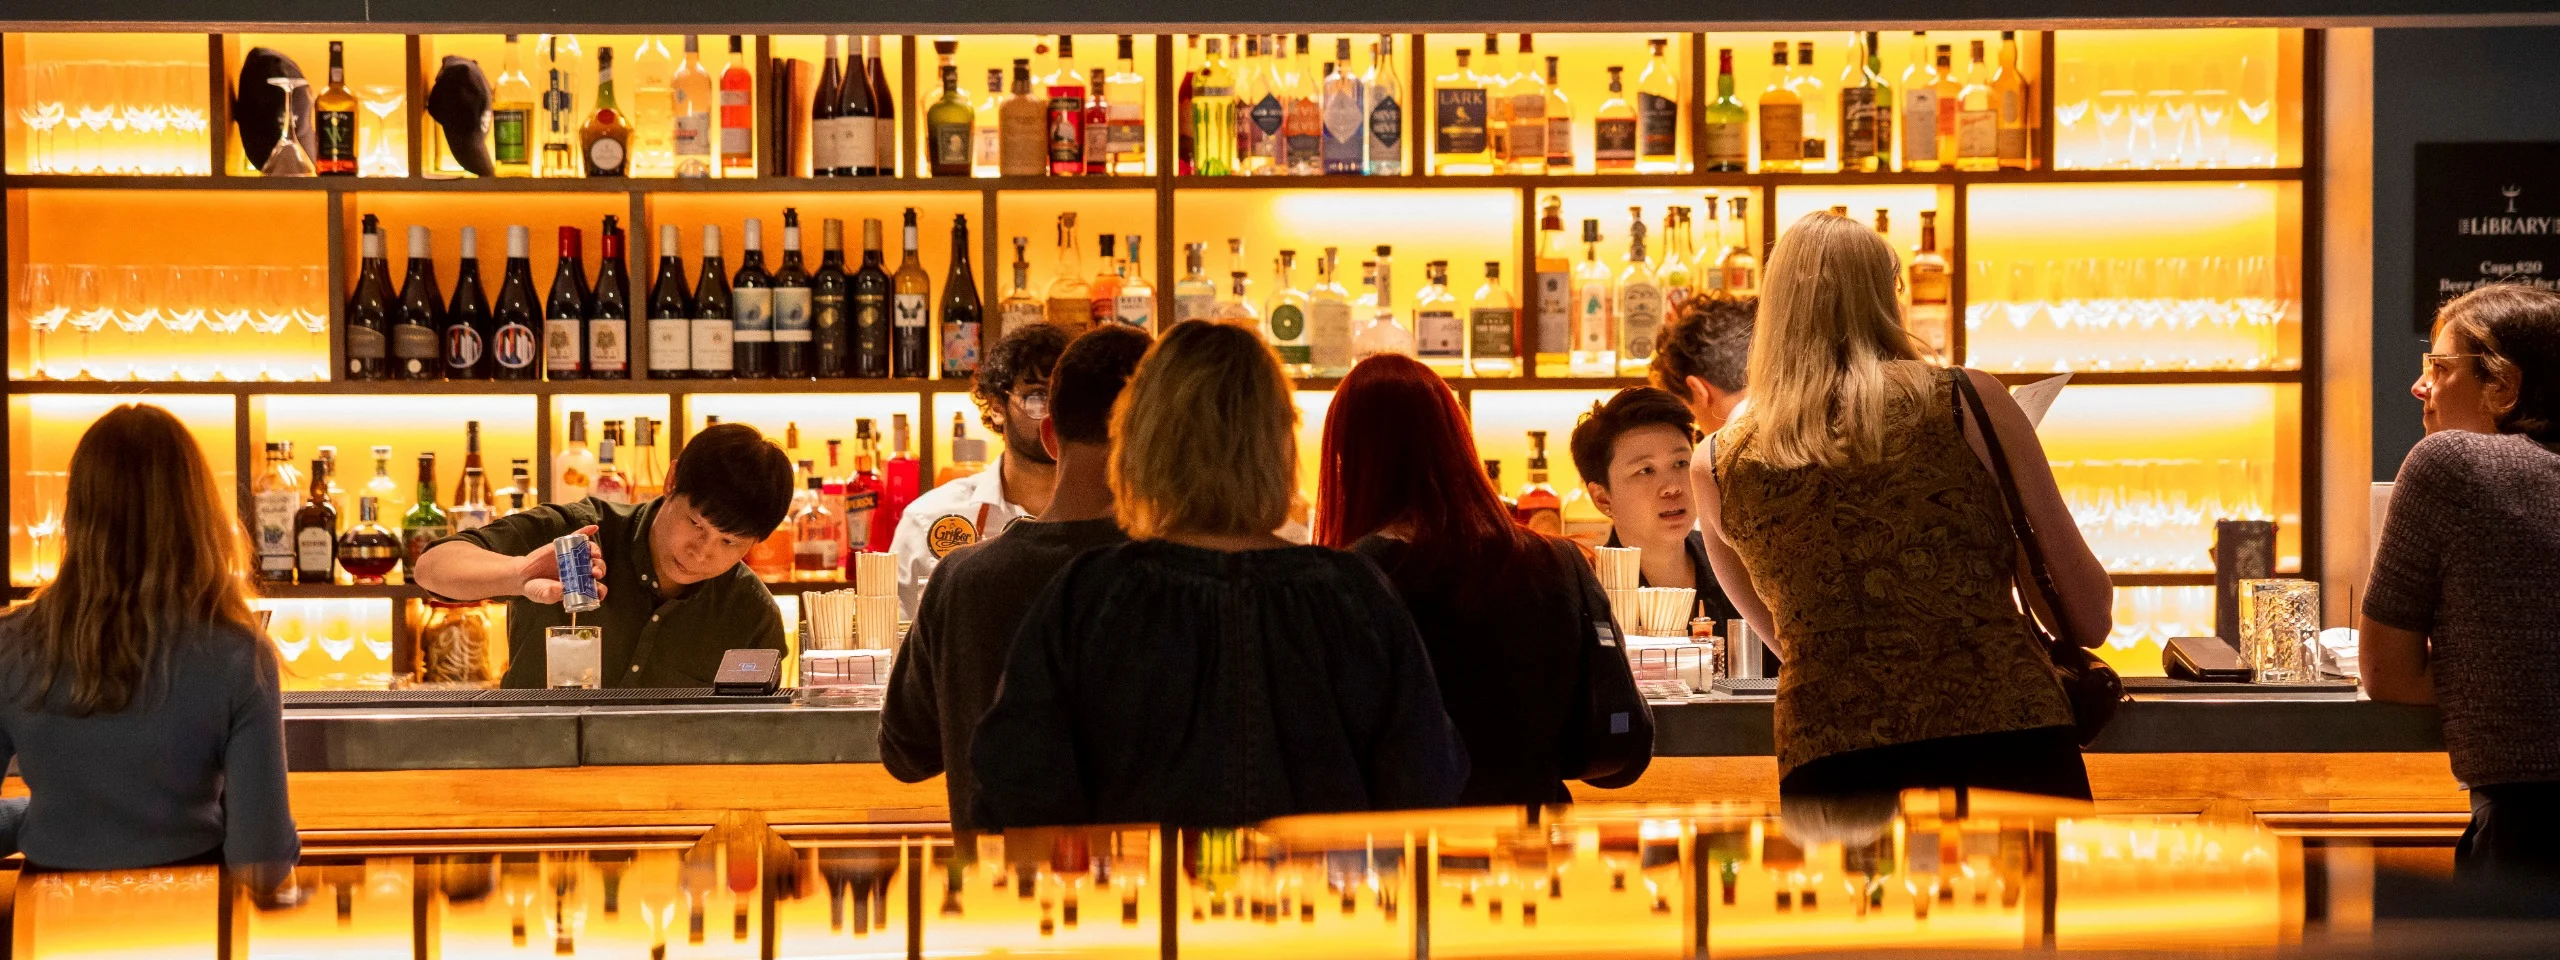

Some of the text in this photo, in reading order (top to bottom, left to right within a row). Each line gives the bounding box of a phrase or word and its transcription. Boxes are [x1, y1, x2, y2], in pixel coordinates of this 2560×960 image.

[1440, 91, 1483, 105] LARK
[2480, 260, 2543, 276] Caps $20
[2440, 278, 2472, 292] Beer
